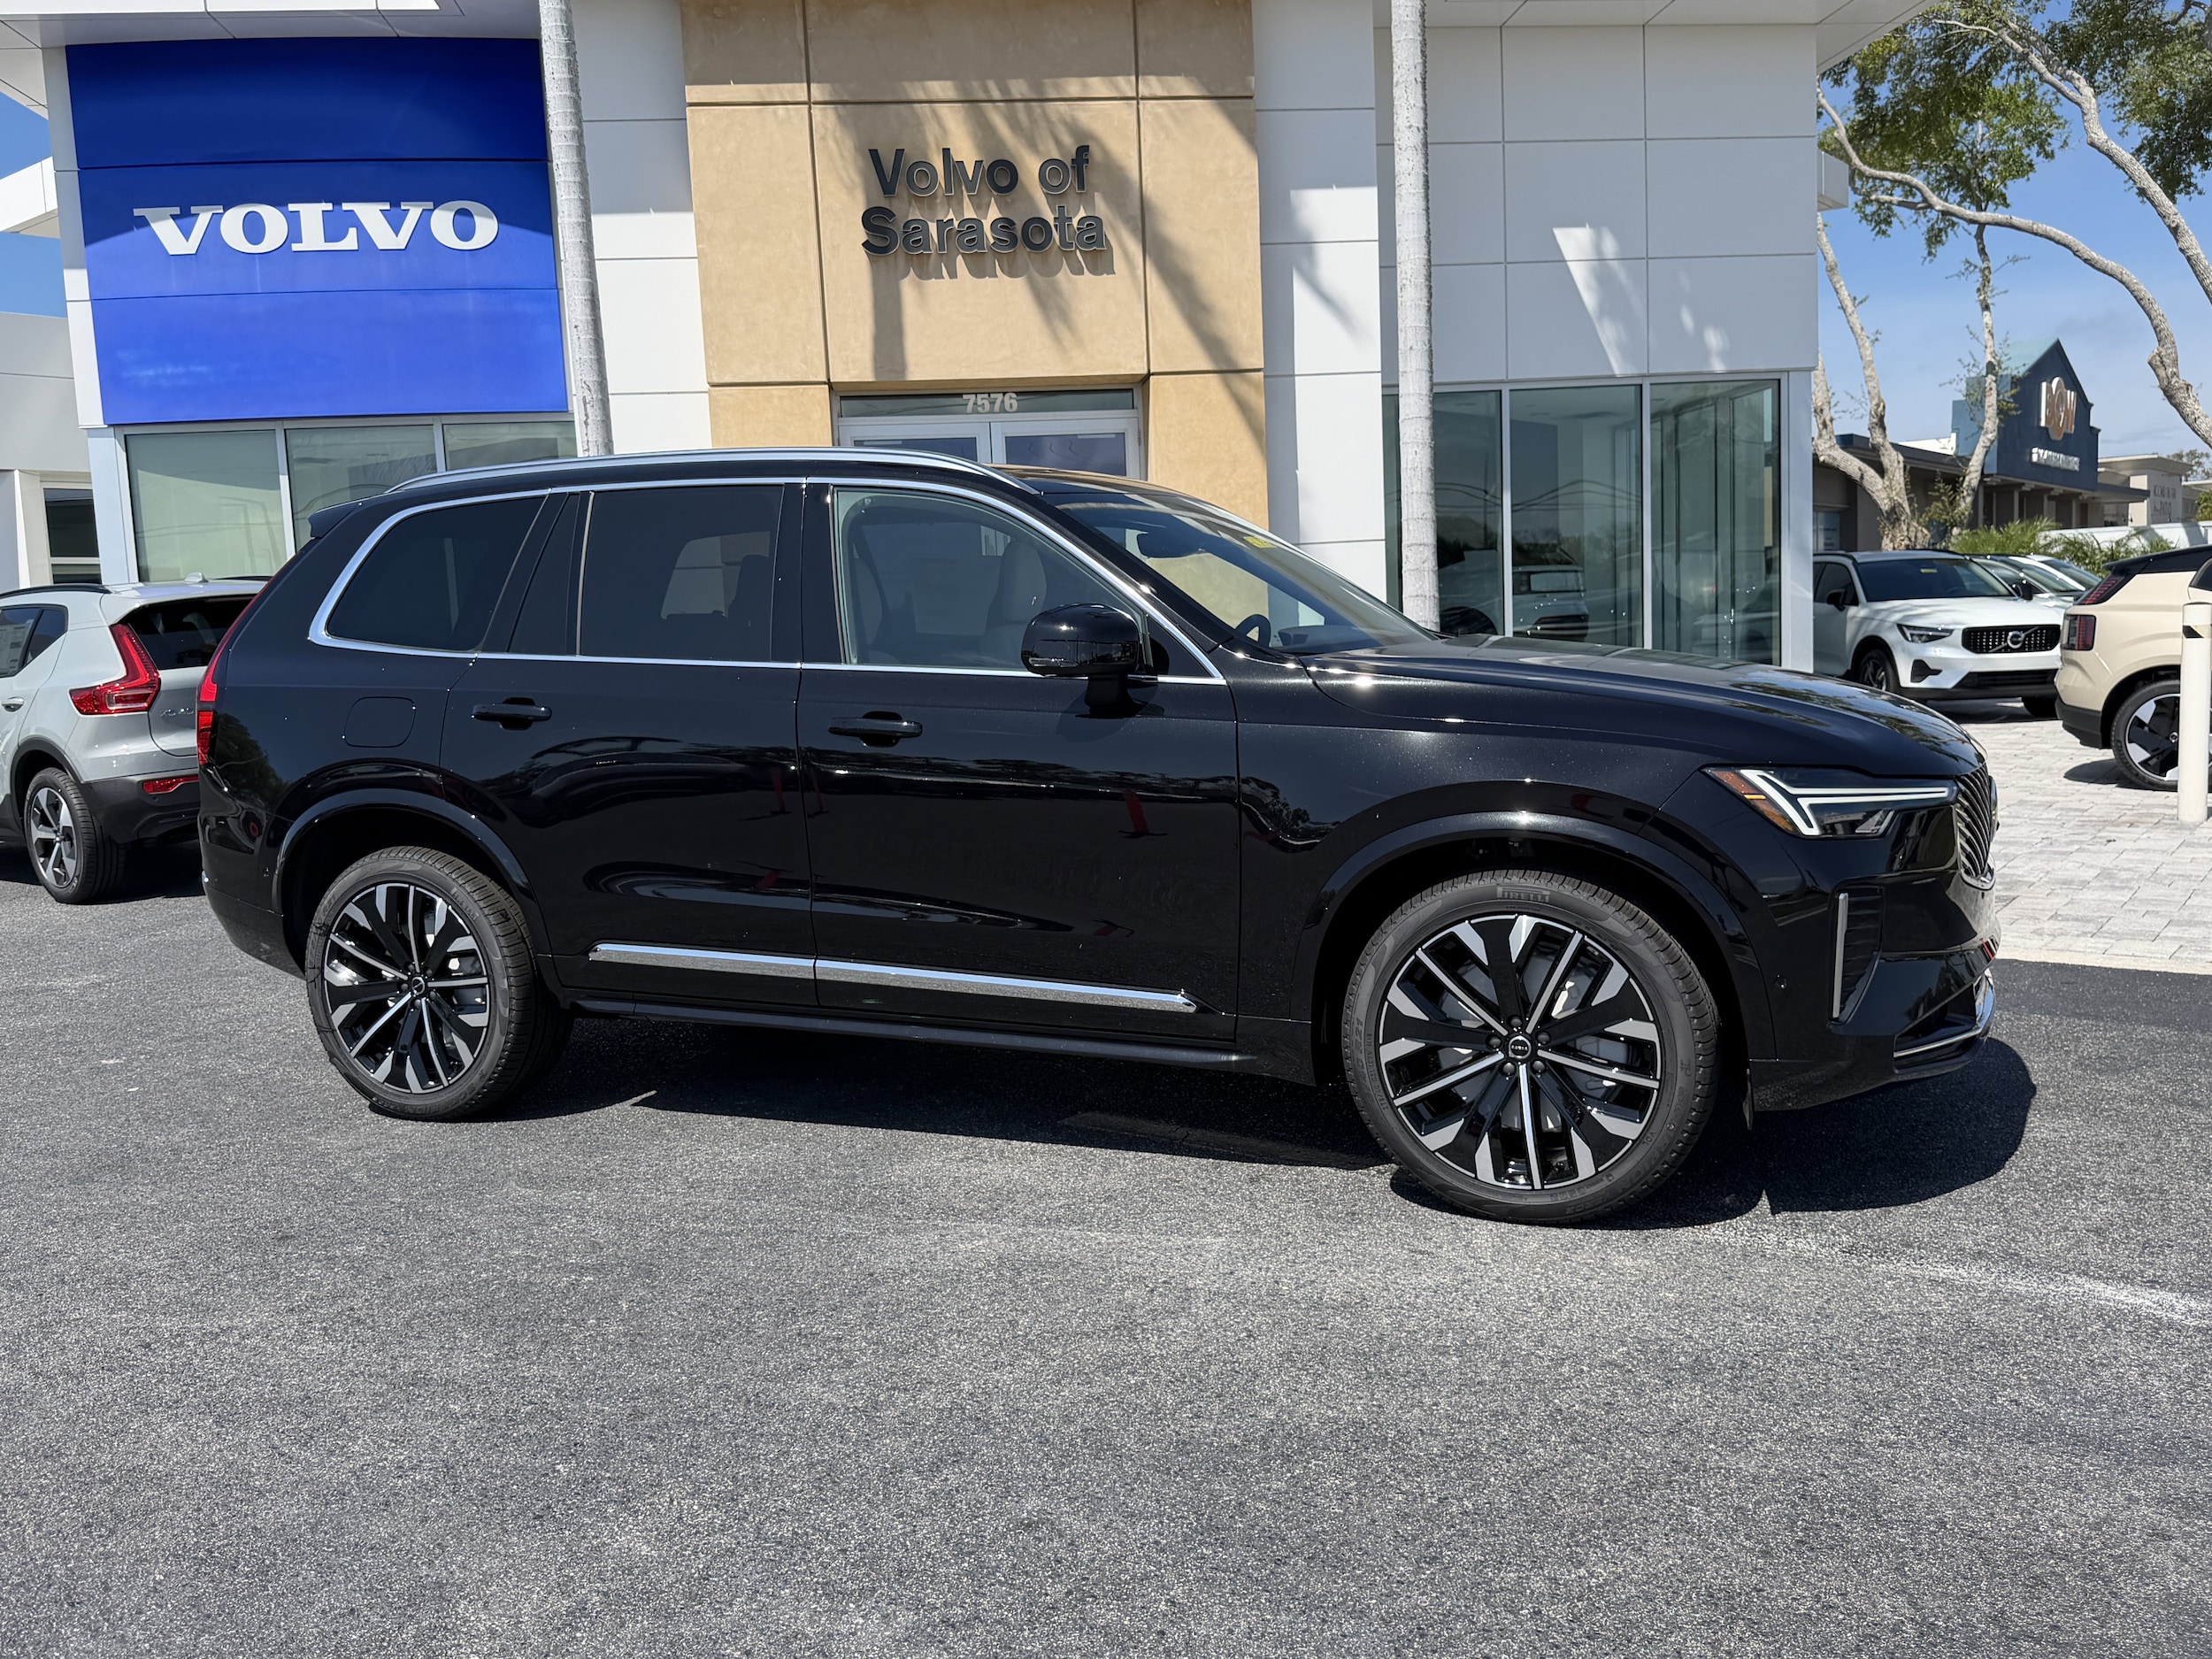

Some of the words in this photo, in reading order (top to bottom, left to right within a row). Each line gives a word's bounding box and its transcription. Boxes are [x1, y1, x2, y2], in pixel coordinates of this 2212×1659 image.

[868, 147, 1019, 197] Volvo
[1038, 144, 1090, 195] of
[133, 200, 499, 256] VOLVO
[861, 204, 1107, 257] Sarasota
[962, 392, 1018, 414] 7576
[1496, 886, 1550, 903] PIRELLI
